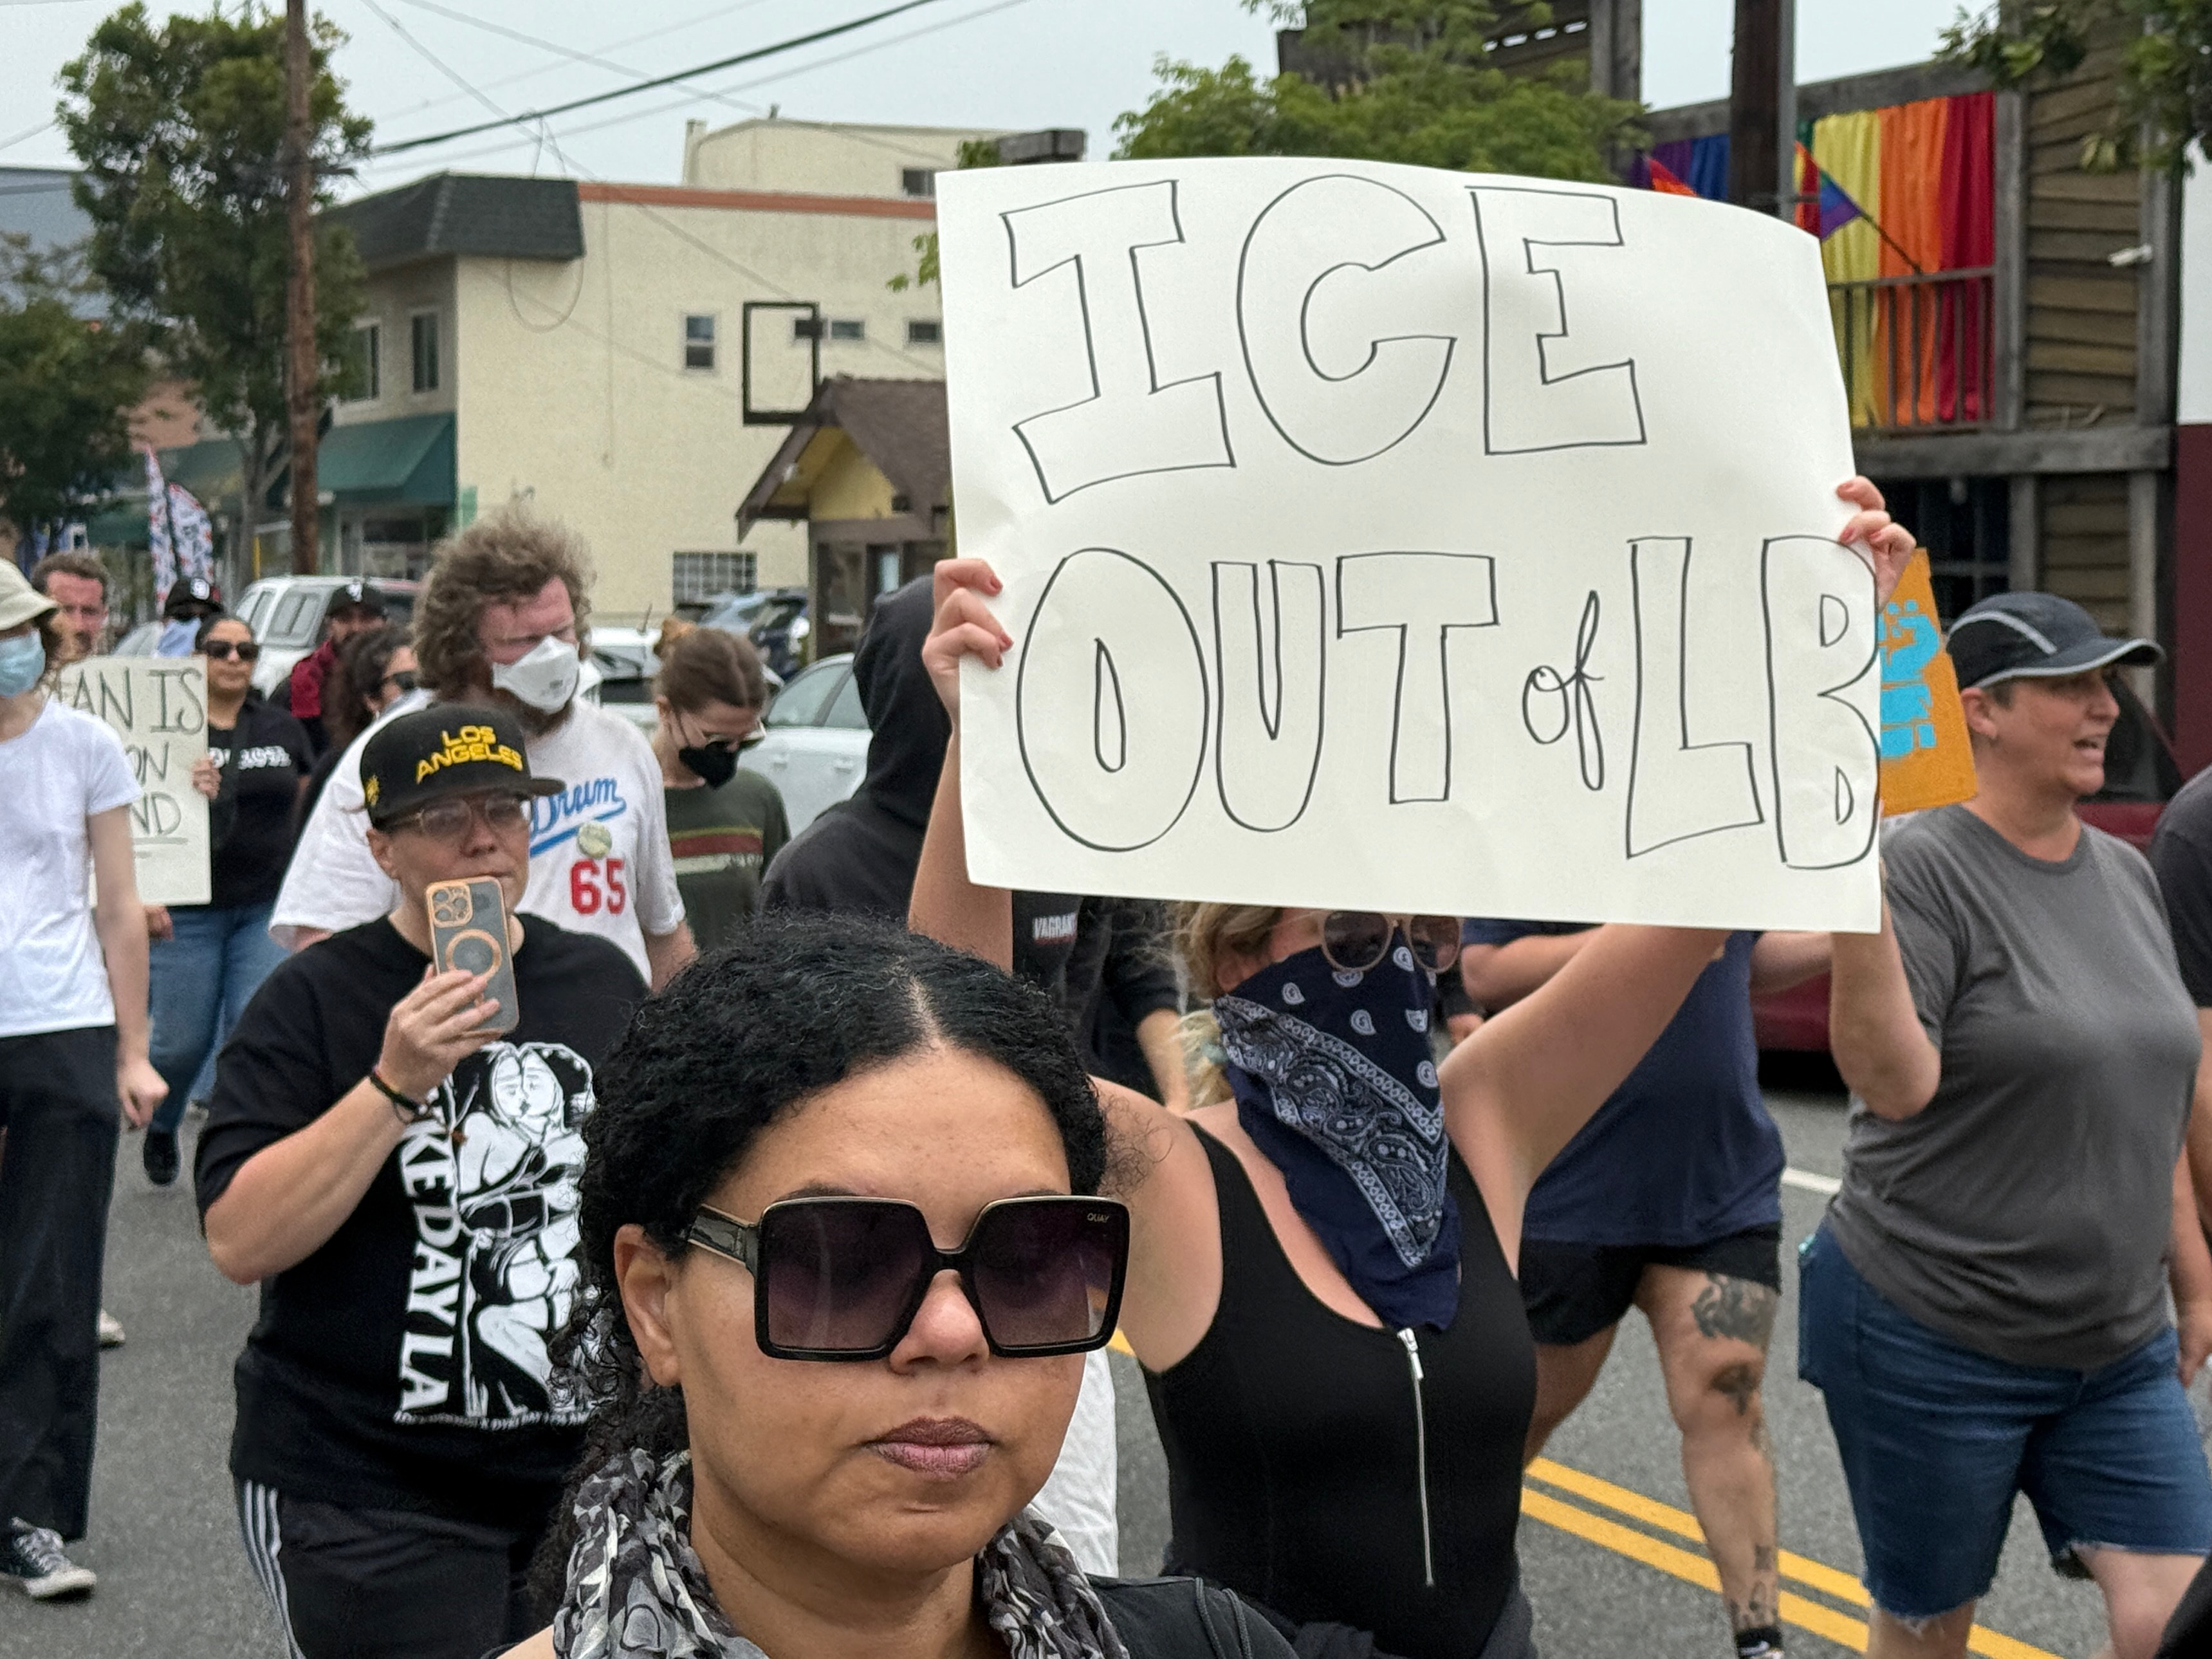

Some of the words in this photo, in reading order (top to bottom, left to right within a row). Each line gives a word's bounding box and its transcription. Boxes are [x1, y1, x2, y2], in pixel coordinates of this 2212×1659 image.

[1000, 173, 1648, 504] ICE
[69, 666, 134, 732] AN
[147, 667, 204, 735] IS
[1016, 546, 1500, 852] OUT
[1522, 589, 1605, 792] of
[1625, 534, 1881, 870] LB
[416, 743, 523, 784] ANGELES
[441, 725, 496, 747] LOS
[130, 792, 181, 837] ND
[570, 858, 625, 915] 65
[1032, 913, 1078, 940] VAGRAN
[400, 1330, 454, 1413] LA
